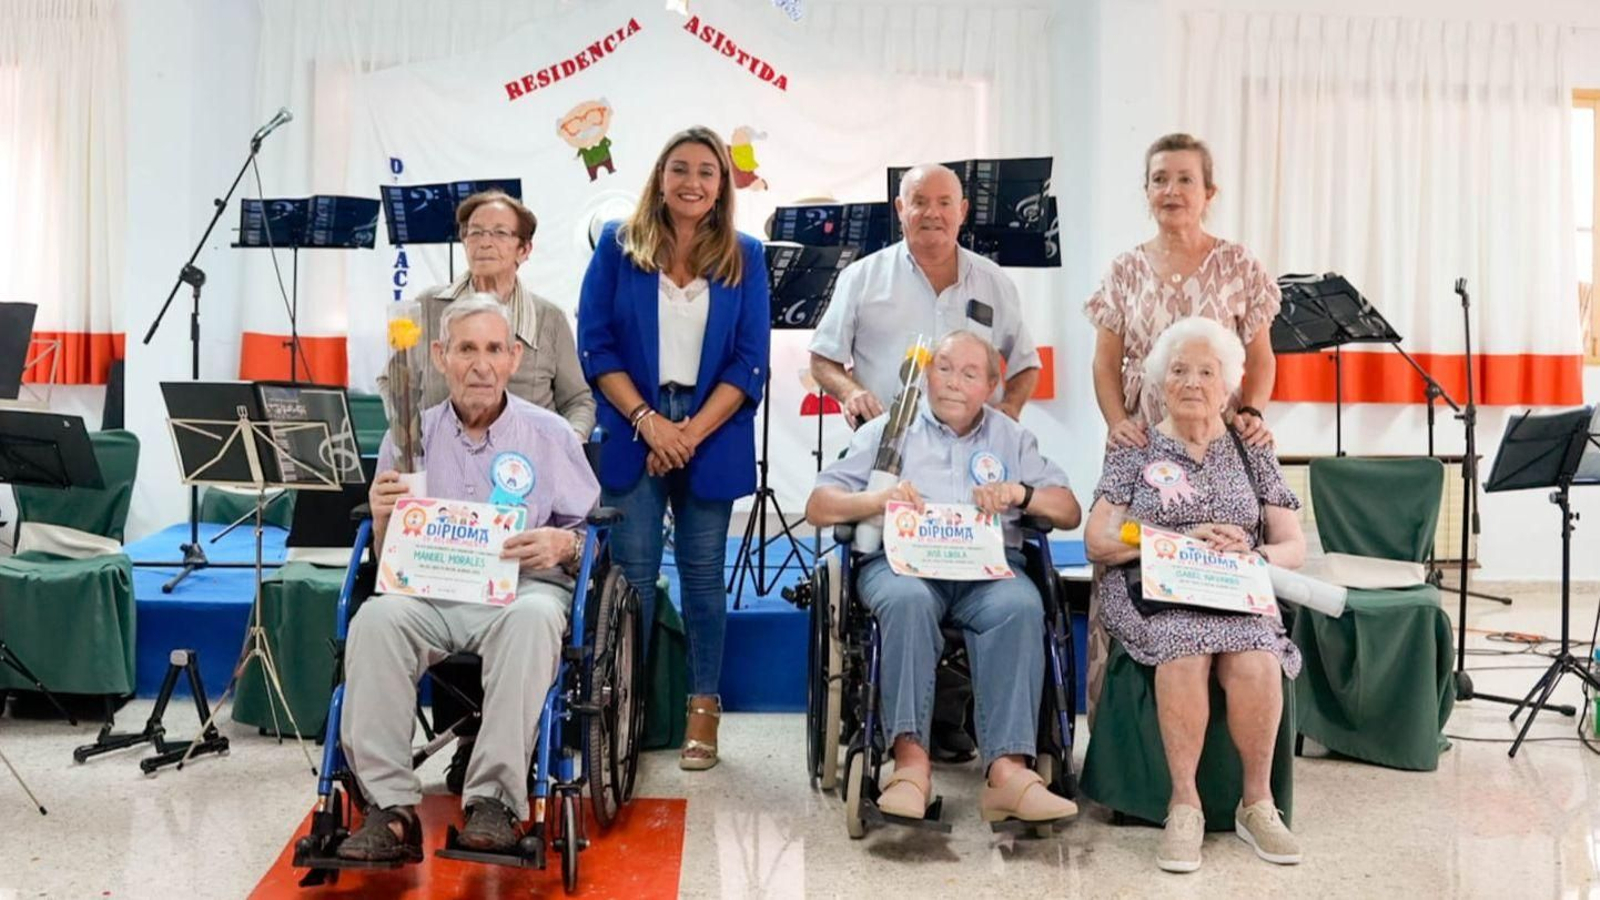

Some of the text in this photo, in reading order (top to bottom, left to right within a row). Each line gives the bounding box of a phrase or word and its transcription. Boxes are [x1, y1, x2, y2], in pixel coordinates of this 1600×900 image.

[504, 15, 788, 101] RESIDENCIA ASISTIDA
[426, 523, 489, 544] DIPLOMA
[919, 525, 974, 540] DIPLOMA
[413, 550, 444, 564] MANUEL
[448, 555, 486, 568] MORALES
[1179, 550, 1238, 570] DIPLOMA
